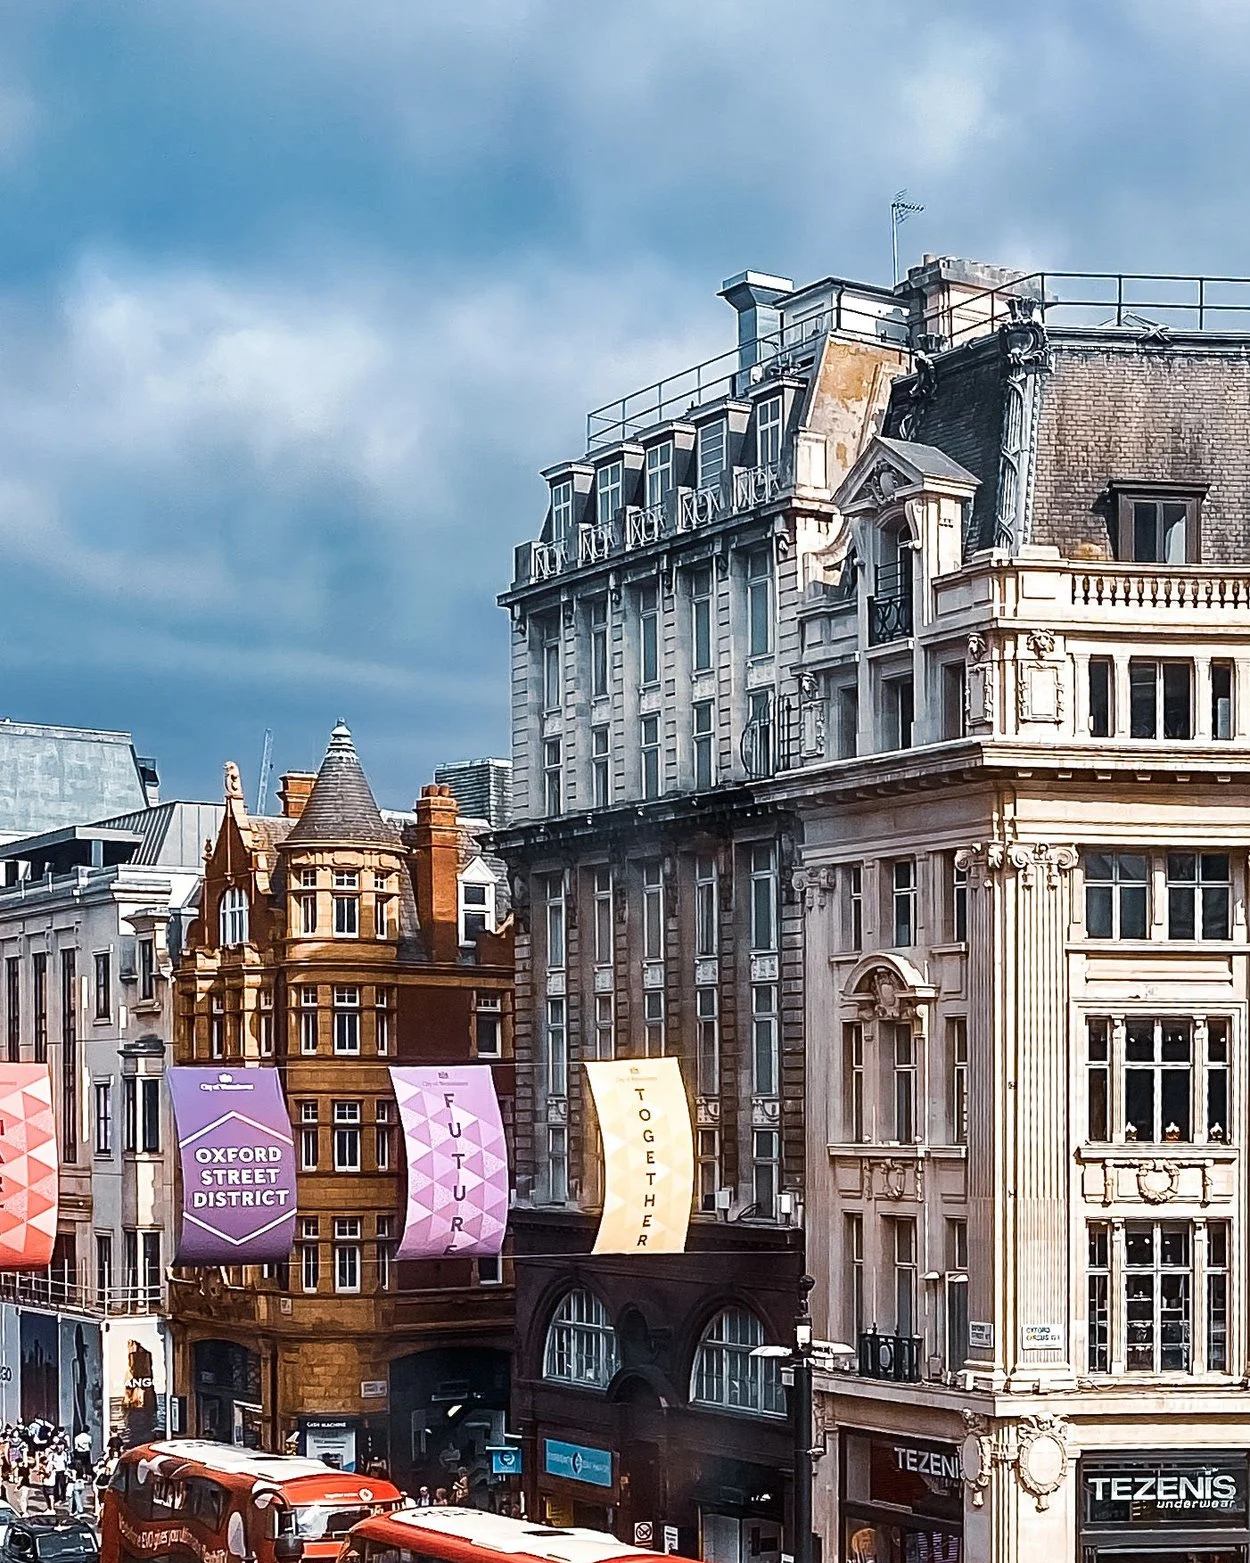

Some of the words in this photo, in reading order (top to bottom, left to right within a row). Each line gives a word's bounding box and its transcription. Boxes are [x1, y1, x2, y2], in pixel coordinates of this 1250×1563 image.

[195, 1147, 282, 1164] OXFORD
[201, 1168, 281, 1187] STREET
[633, 1088, 656, 1247] TOGETHER
[193, 1189, 290, 1209] DISTRICT
[893, 1447, 961, 1479] TEZENI
[1087, 1467, 1238, 1501] TEZENIS
[1156, 1499, 1237, 1510] underwear
